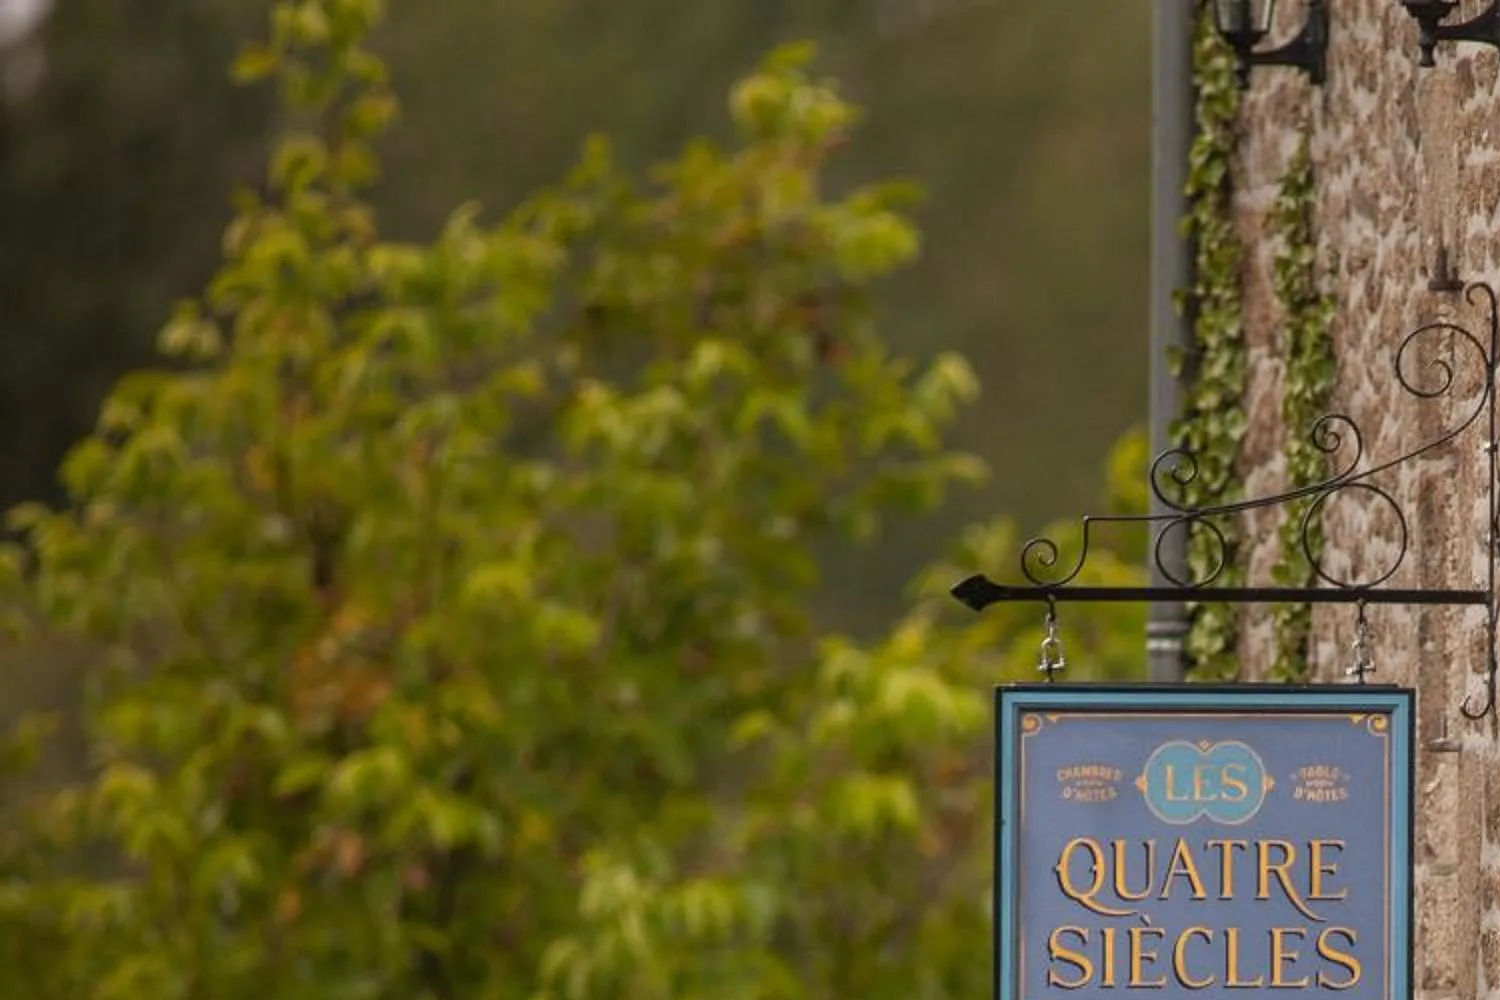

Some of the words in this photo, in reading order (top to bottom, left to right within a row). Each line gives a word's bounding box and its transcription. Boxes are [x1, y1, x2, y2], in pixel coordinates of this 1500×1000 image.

[1164, 764, 1249, 802] LES
[1053, 837, 1347, 922] QUATRE
[1047, 912, 1361, 990] SIÈCLES
